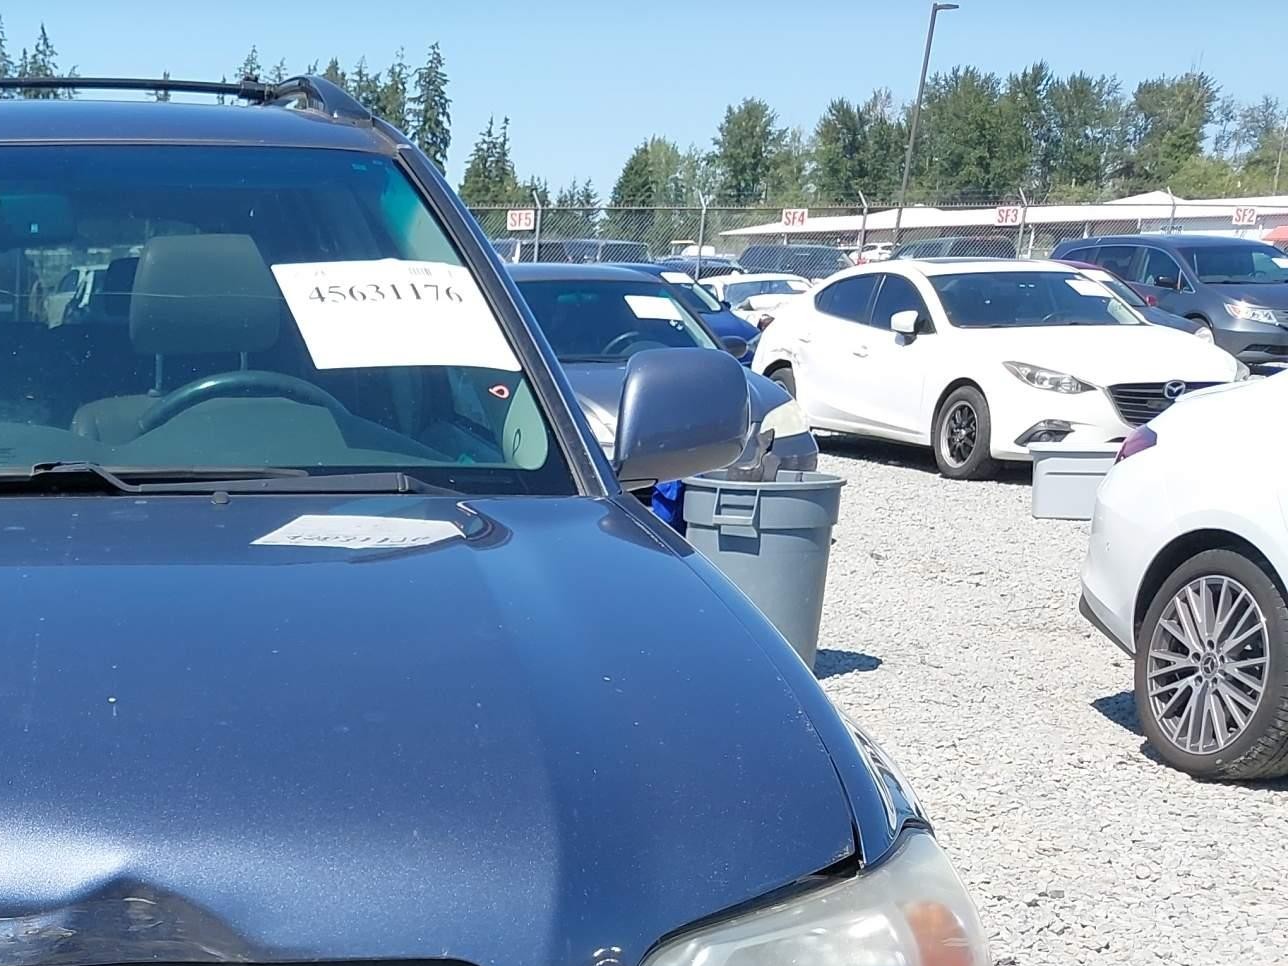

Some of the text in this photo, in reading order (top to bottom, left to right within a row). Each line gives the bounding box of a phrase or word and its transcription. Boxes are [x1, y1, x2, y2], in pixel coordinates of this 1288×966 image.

[509, 212, 532, 228] SF5
[783, 211, 805, 227] SF4
[997, 207, 1019, 223] SF3
[1234, 208, 1256, 223] SF2
[308, 282, 464, 304] 45631176
